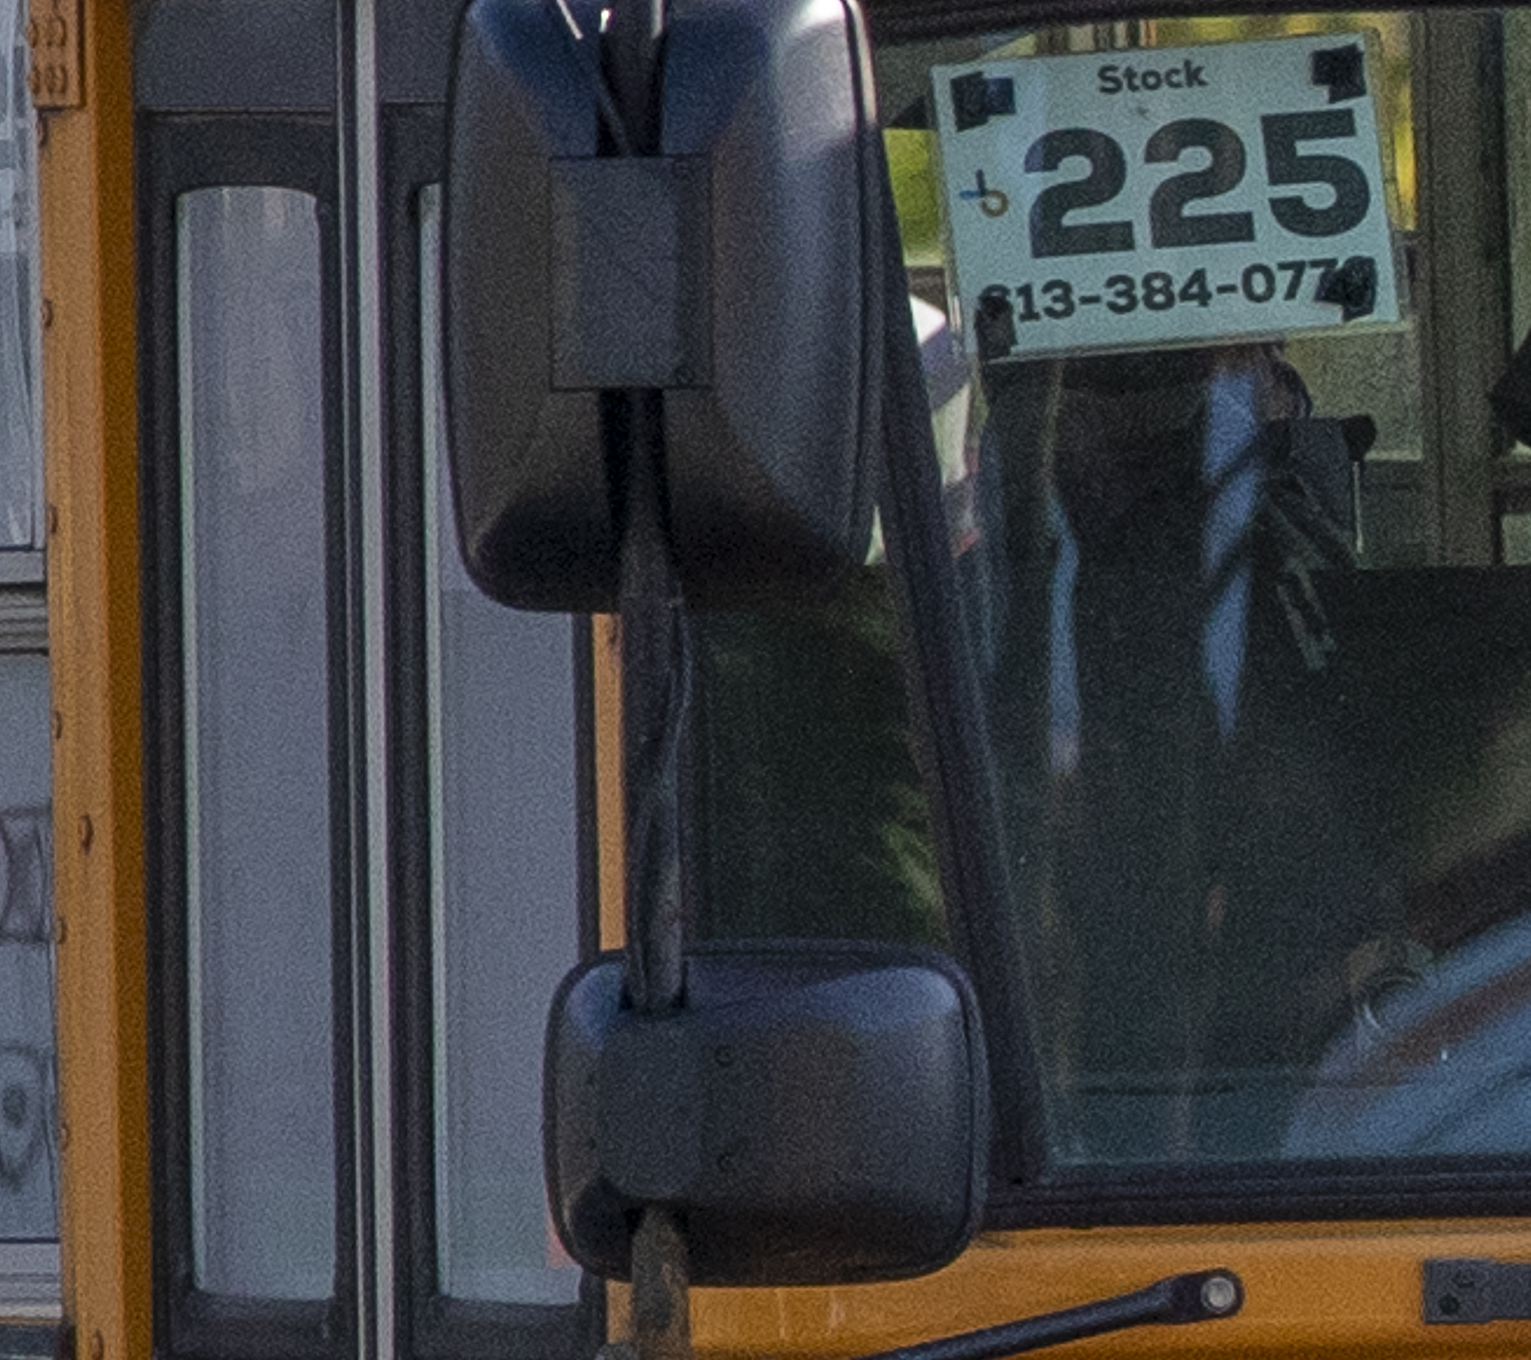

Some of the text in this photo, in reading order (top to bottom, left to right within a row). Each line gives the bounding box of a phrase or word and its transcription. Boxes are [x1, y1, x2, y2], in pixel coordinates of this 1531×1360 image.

[1098, 59, 1208, 94] Stock
[1023, 108, 1371, 259] 225
[977, 255, 1376, 324] 13-384-077
